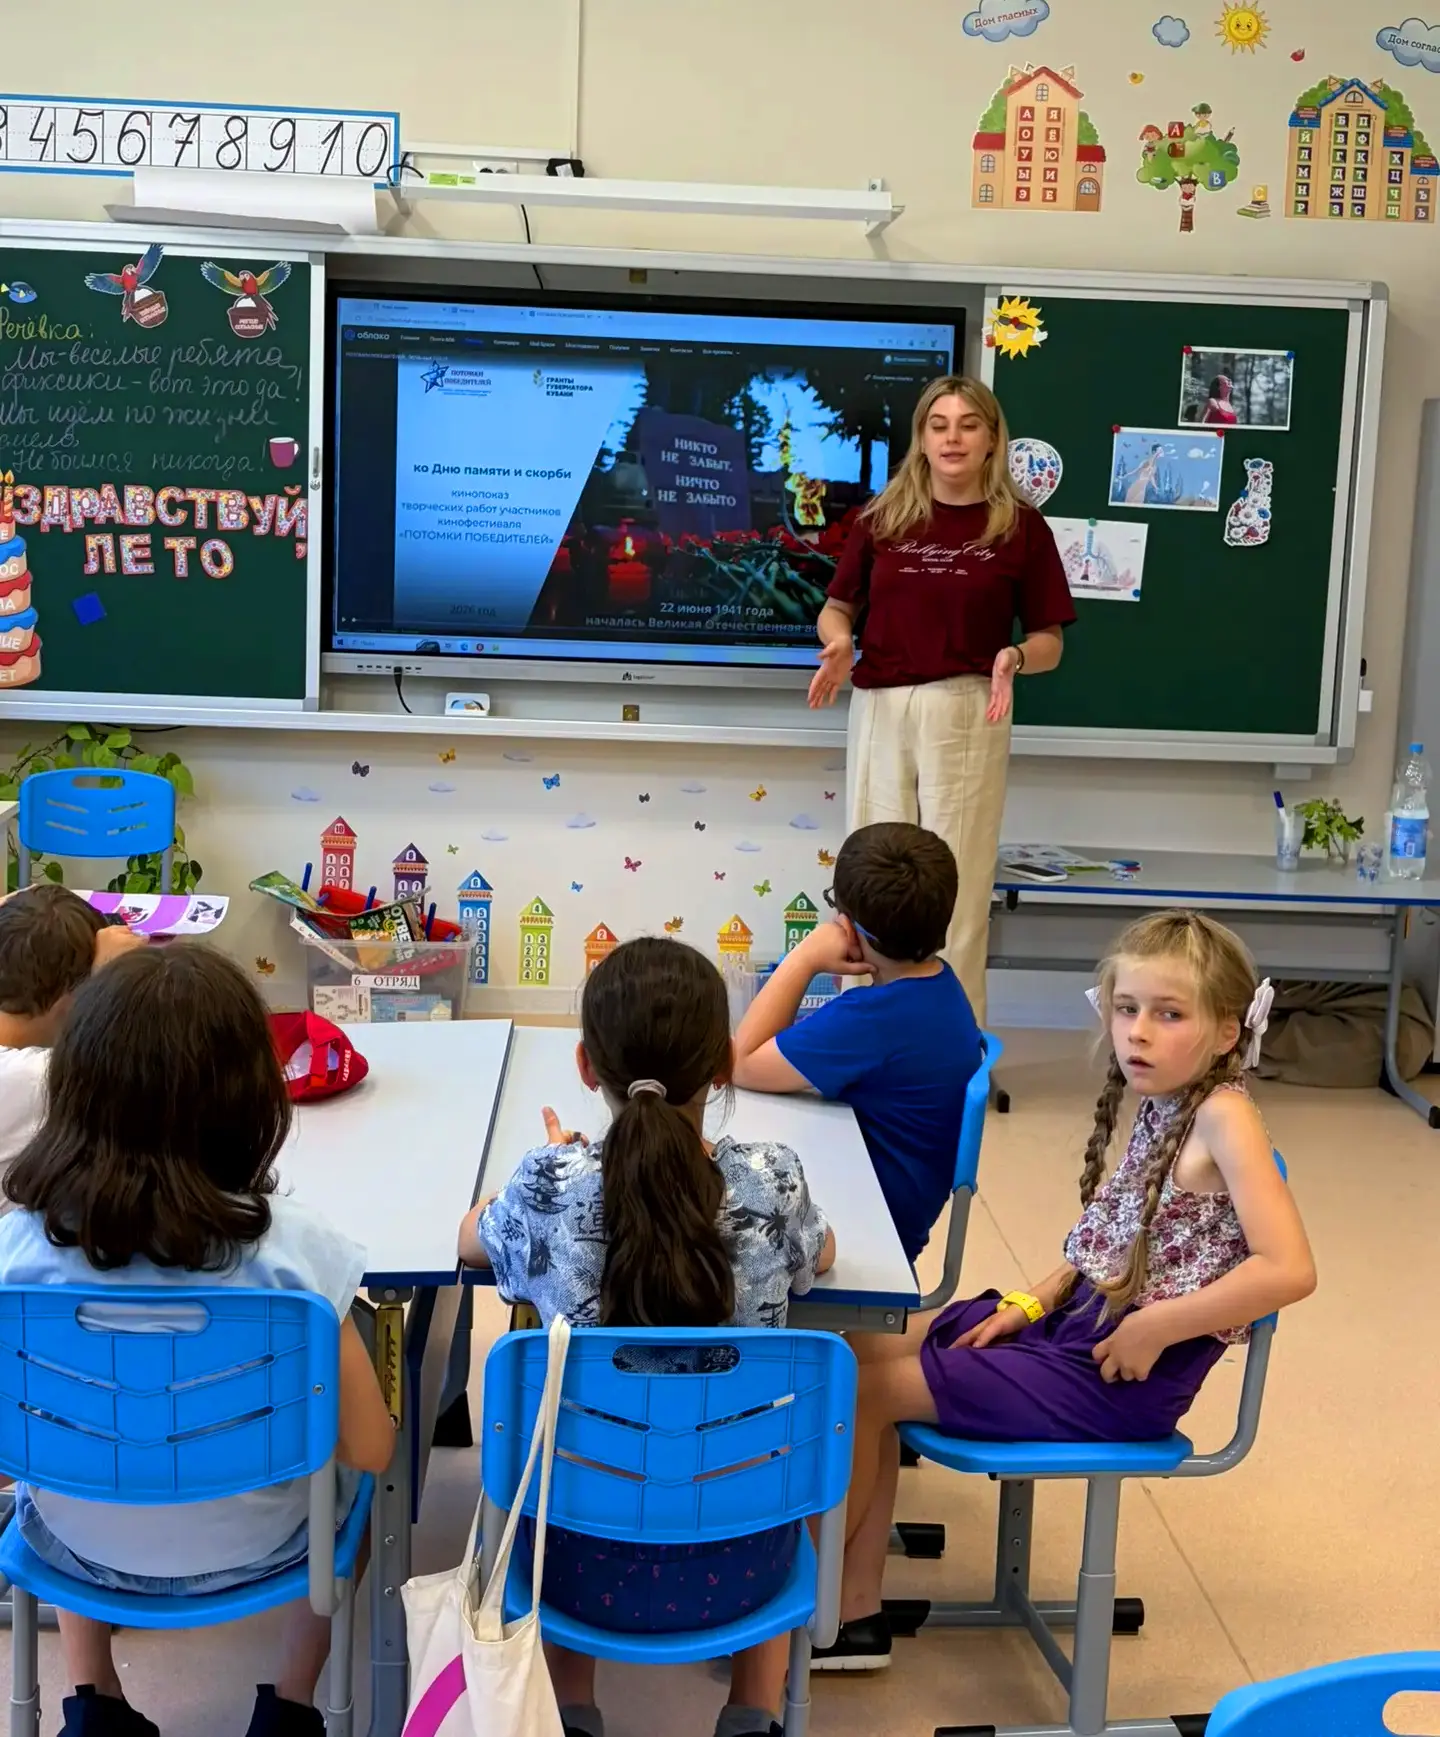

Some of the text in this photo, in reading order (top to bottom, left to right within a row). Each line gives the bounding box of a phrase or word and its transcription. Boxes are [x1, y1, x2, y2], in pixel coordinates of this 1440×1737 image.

[974, 7, 1038, 28] Дом гласных
[1387, 34, 1409, 45] Дом
[1022, 109, 1058, 119] А Я
[29, 106, 55, 161] 4
[66, 108, 104, 163] 5
[117, 111, 151, 166] 6
[168, 112, 201, 168] 7
[215, 115, 248, 170] 8
[263, 117, 296, 172] 9
[1021, 129, 1057, 140] О Ё
[1020, 149, 1058, 160] У Ю
[1018, 169, 1055, 180] Ы И
[1018, 189, 1054, 200] Э Е
[150, 368, 194, 393] вот
[202, 375, 249, 396] это
[546, 376, 575, 384] ГРАНТЫ
[125, 405, 156, 424] по
[674, 437, 717, 455] НИКТО
[661, 450, 680, 464] НЕ
[413, 463, 572, 480] ко Дню памяти и скорби
[675, 474, 720, 490] НИЧТО
[451, 489, 510, 500] кинопоказ
[658, 489, 737, 507] НЕ ЗАБЫТО
[401, 501, 562, 517] творческих работ участников
[437, 518, 522, 530] кинофестиваля
[962, 541, 996, 561] City
[660, 602, 774, 618] 22 июня 1941 года
[586, 616, 645, 628] началась
[648, 617, 701, 629] Великая
[705, 619, 800, 633] Отечественная
[354, 976, 418, 989] 6 ОТРЯД
[800, 997, 832, 1008] ОТР
